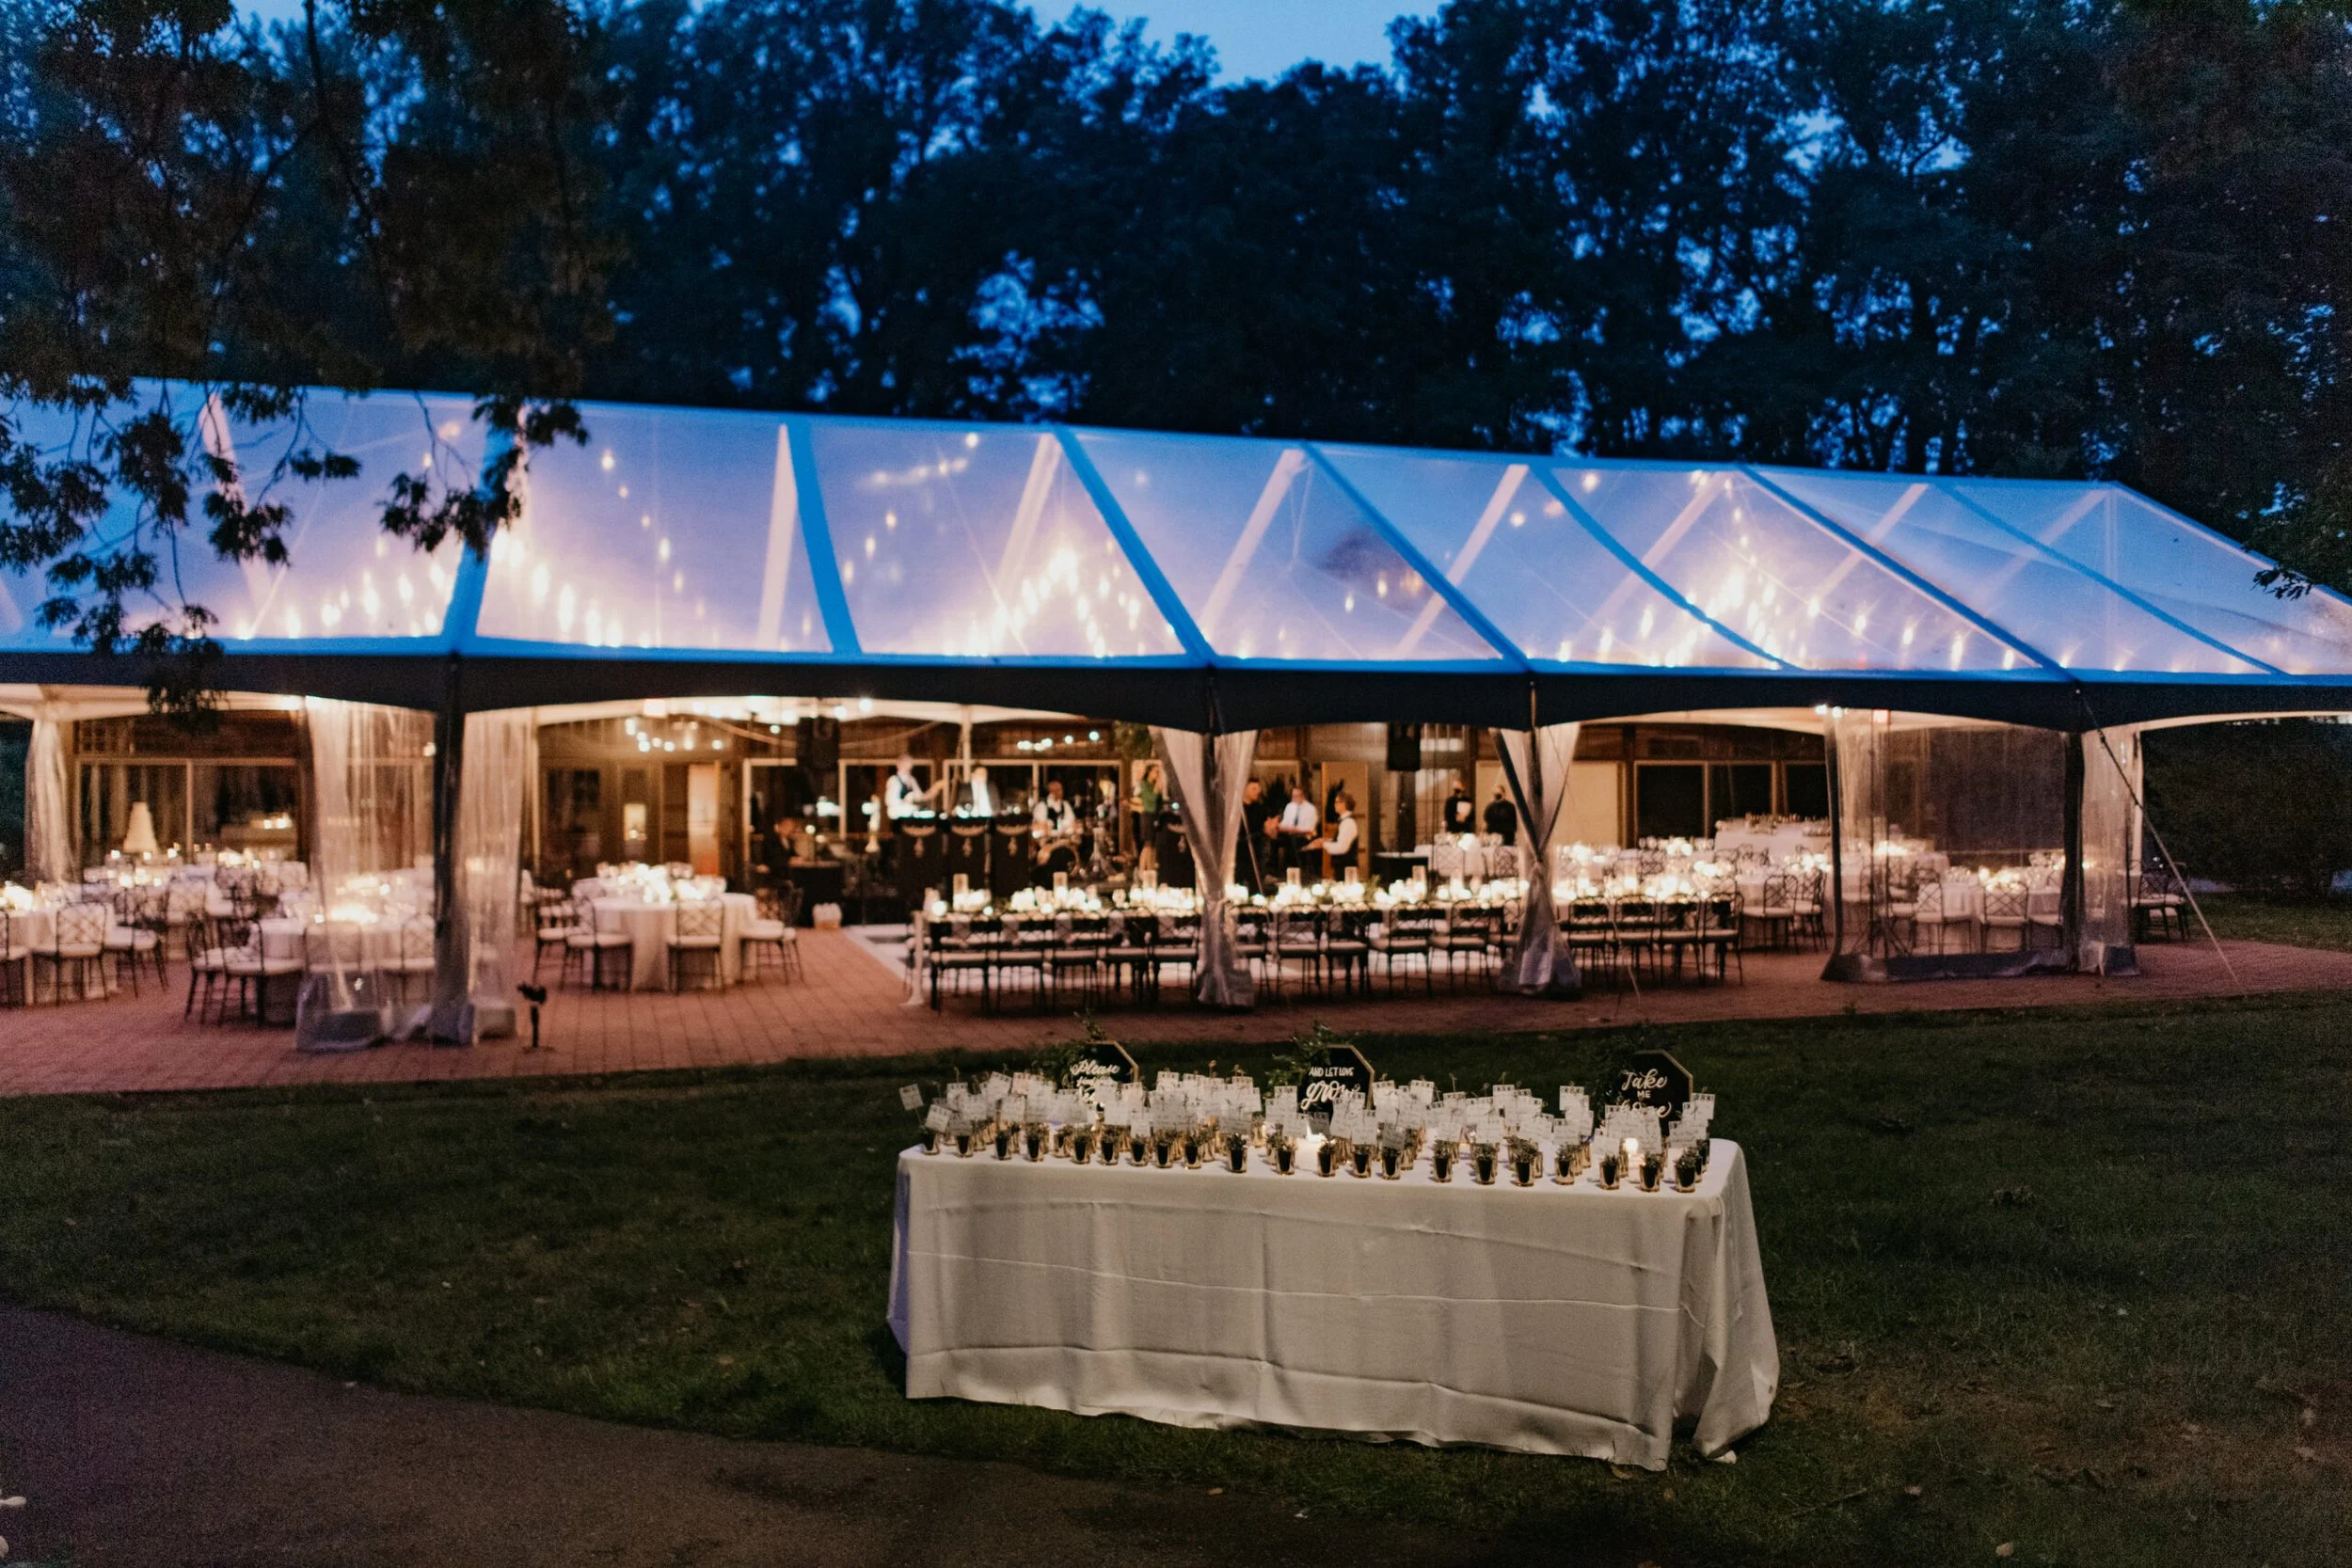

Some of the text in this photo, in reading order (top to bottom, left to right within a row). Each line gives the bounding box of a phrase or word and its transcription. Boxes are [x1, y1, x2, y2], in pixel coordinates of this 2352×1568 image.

[1070, 1059, 1120, 1075] Please
[1309, 1067, 1354, 1077] AND LET LOVE
[1620, 1069, 1667, 1091] Take
